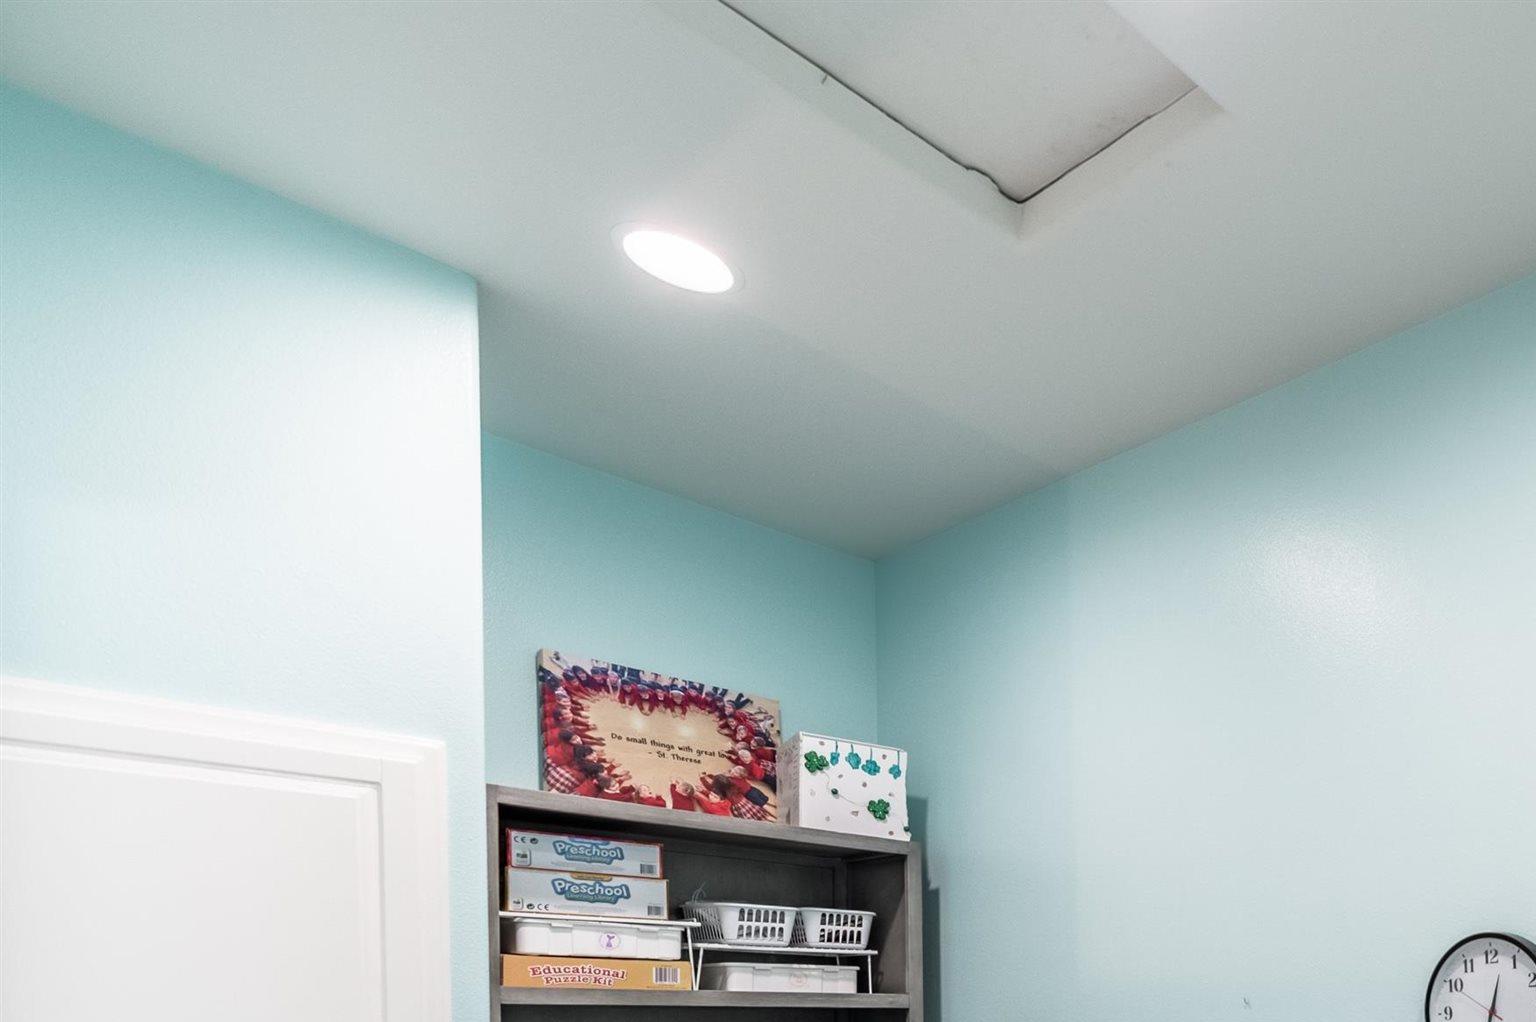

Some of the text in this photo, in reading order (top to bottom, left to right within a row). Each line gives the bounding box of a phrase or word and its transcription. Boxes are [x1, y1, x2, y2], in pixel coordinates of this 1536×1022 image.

[611, 732, 623, 741] Do
[626, 736, 648, 745] small
[650, 739, 675, 752] things
[678, 746, 693, 754] with
[696, 749, 716, 757] great
[671, 753, 702, 765] Therese
[554, 841, 624, 859] Preschool
[553, 879, 630, 898] Preschool
[1484, 948, 1499, 965] 12
[1511, 954, 1517, 970] 1
[530, 965, 627, 979] Educational
[1463, 958, 1475, 973] 11
[544, 975, 614, 986] Puzzle Kit
[1448, 978, 1464, 993] 10
[1443, 1005, 1453, 1021] 9
